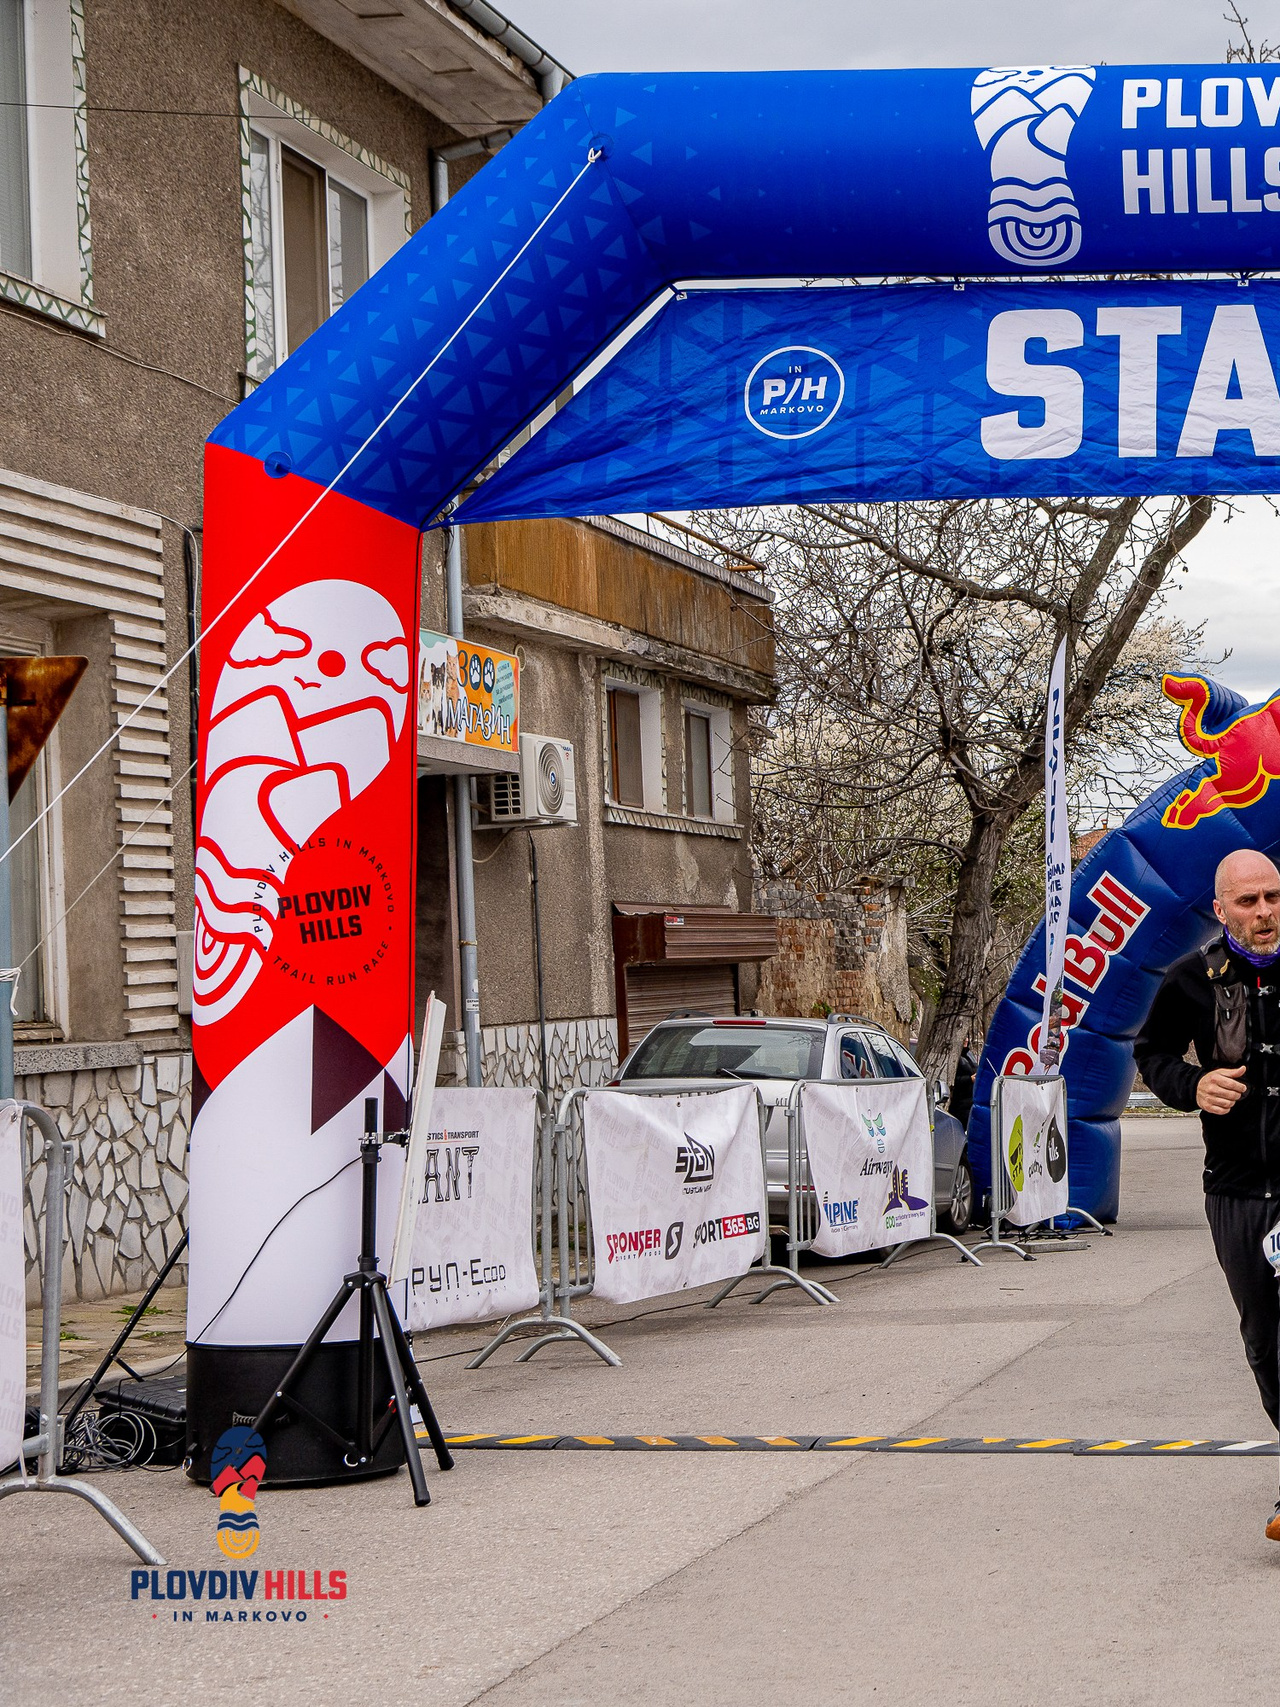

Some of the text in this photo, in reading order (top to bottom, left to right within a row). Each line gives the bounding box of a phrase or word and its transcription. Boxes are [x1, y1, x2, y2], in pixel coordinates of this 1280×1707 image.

[788, 365, 802, 373] IN
[762, 376, 828, 406] P/H
[760, 405, 824, 415] MARKOVO
[447, 697, 512, 744] МАГАЗИН
[252, 837, 395, 934] PLOVDIV HILLS IN MARKOVO
[277, 884, 372, 920] PLOVDIV
[299, 914, 363, 945] HILLS
[1064, 875, 1146, 990] Bull
[272, 940, 390, 986] TRAIL RUN RACE
[447, 1130, 479, 1140] TRANSPORT
[860, 1158, 894, 1179] Airways
[606, 1228, 662, 1264] SPONSER
